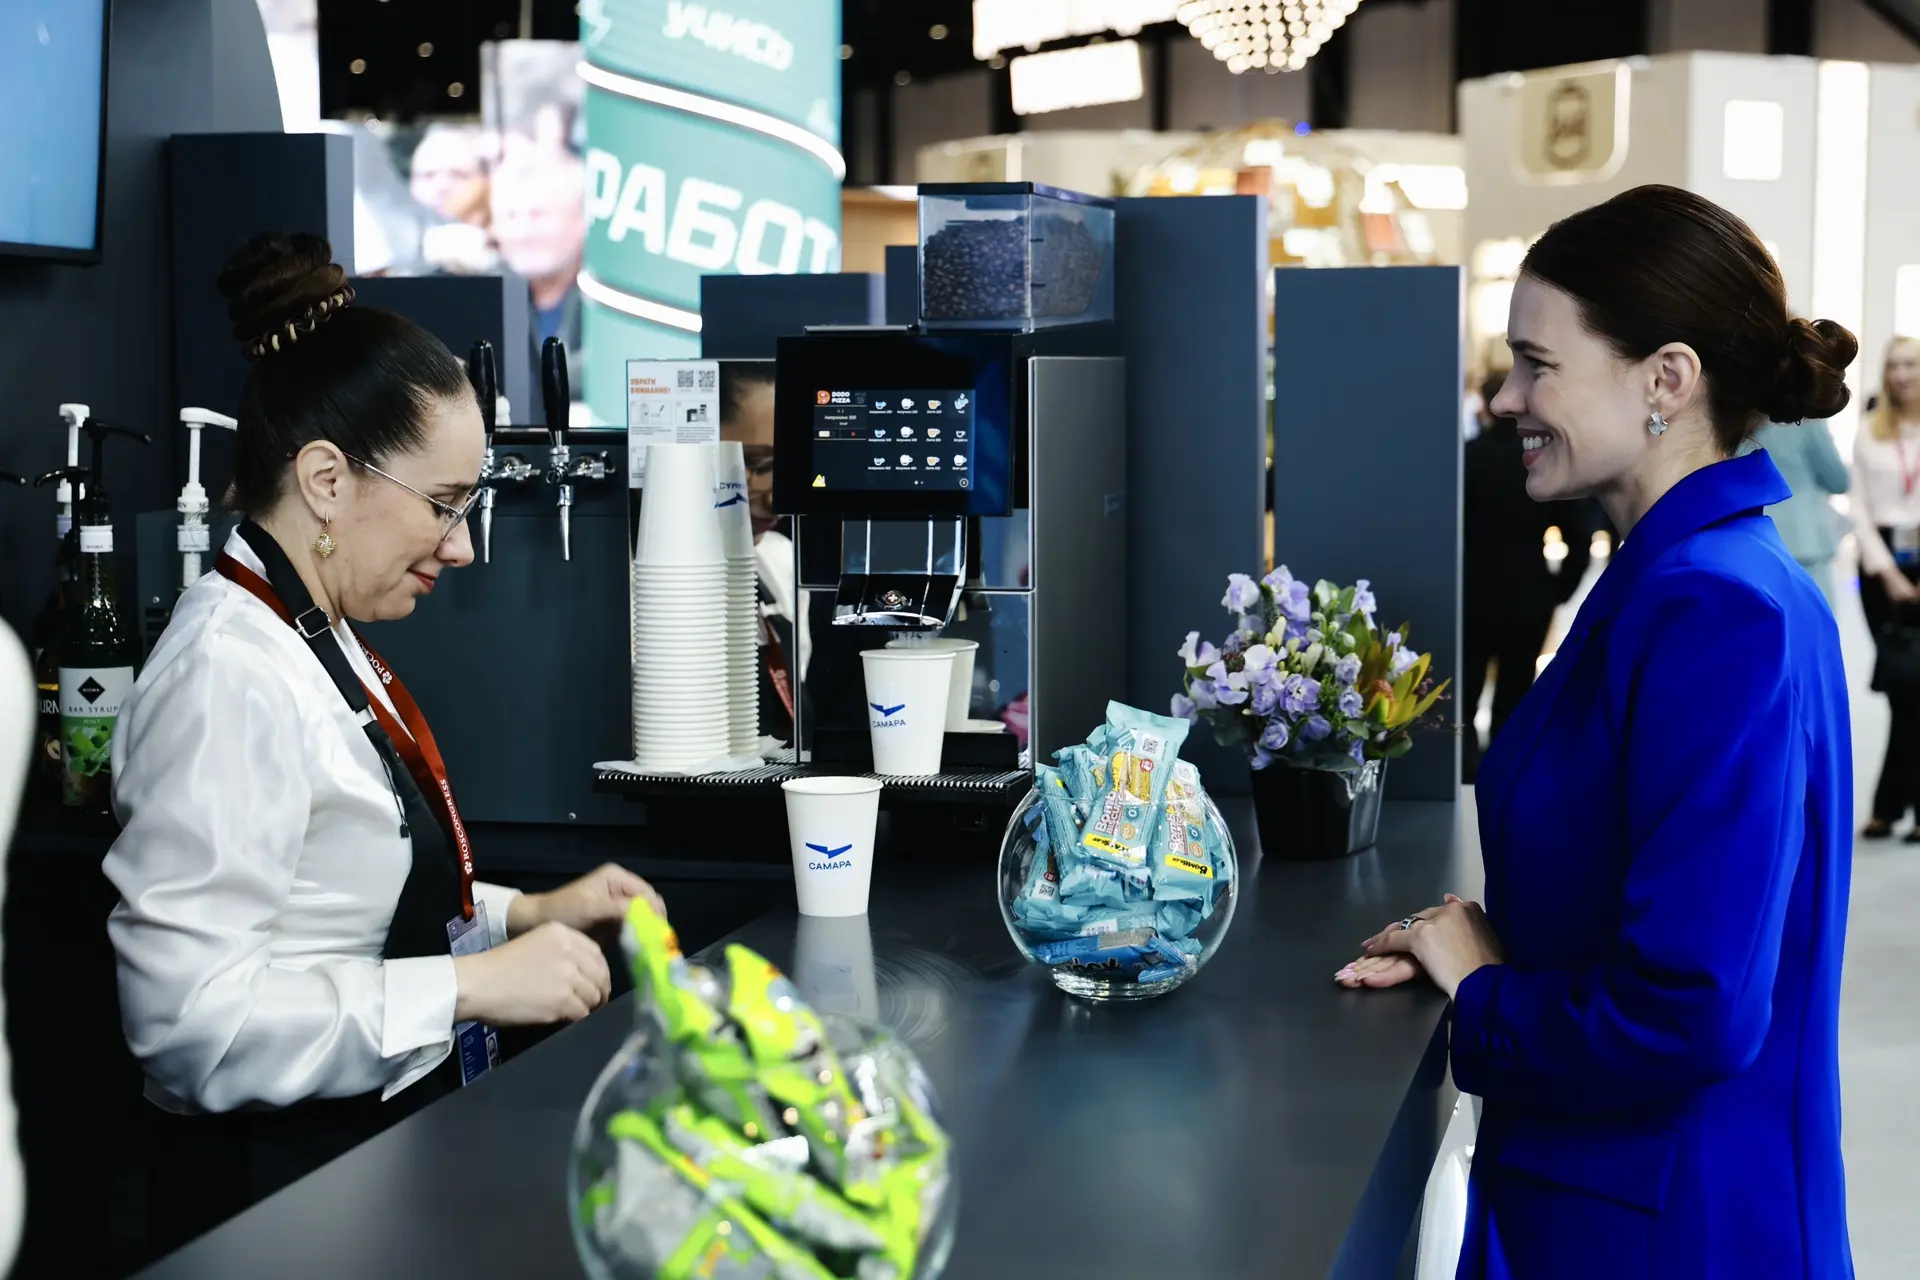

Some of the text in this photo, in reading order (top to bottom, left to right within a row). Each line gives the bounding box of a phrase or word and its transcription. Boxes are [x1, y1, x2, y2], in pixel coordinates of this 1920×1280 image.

[88, 705, 119, 713] SYRUP
[872, 718, 907, 728] САМАРА
[440, 779, 470, 860] ROSCONGRESS
[808, 859, 852, 870] САМАРА
